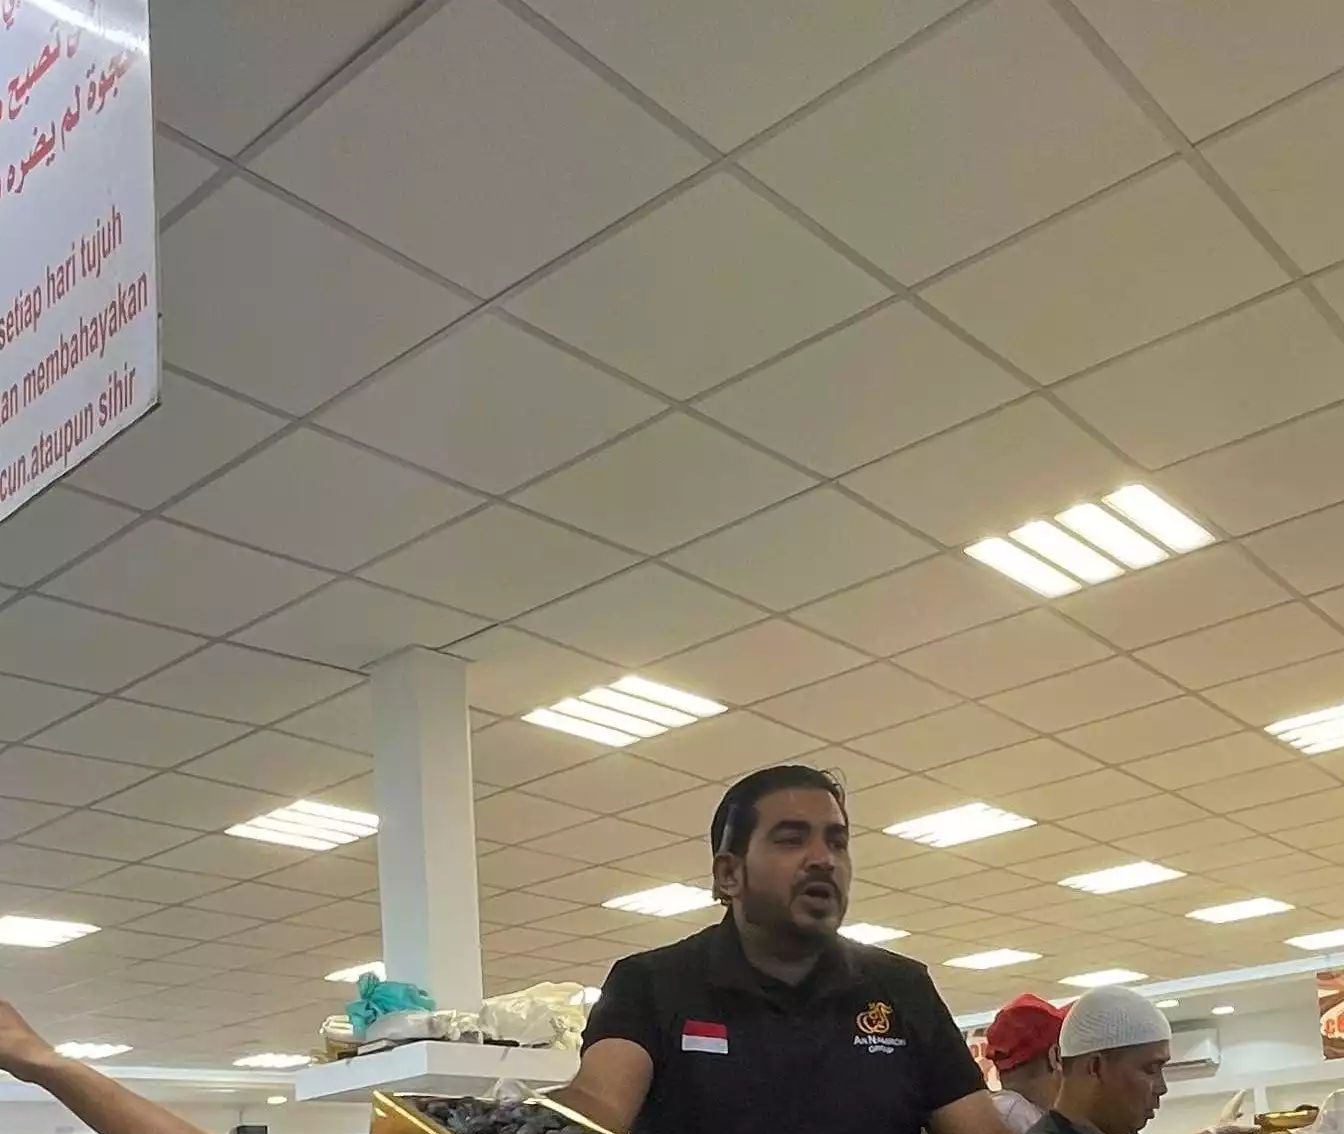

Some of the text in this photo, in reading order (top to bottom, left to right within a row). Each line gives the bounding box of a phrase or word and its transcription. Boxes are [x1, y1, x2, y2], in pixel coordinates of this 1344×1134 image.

[60, 84, 81, 151] لم
[6, 119, 57, 194] يضره
[45, 241, 77, 310] hari
[80, 204, 124, 279] tujuh
[22, 272, 149, 408] membahayakan
[98, 361, 137, 430] sihir
